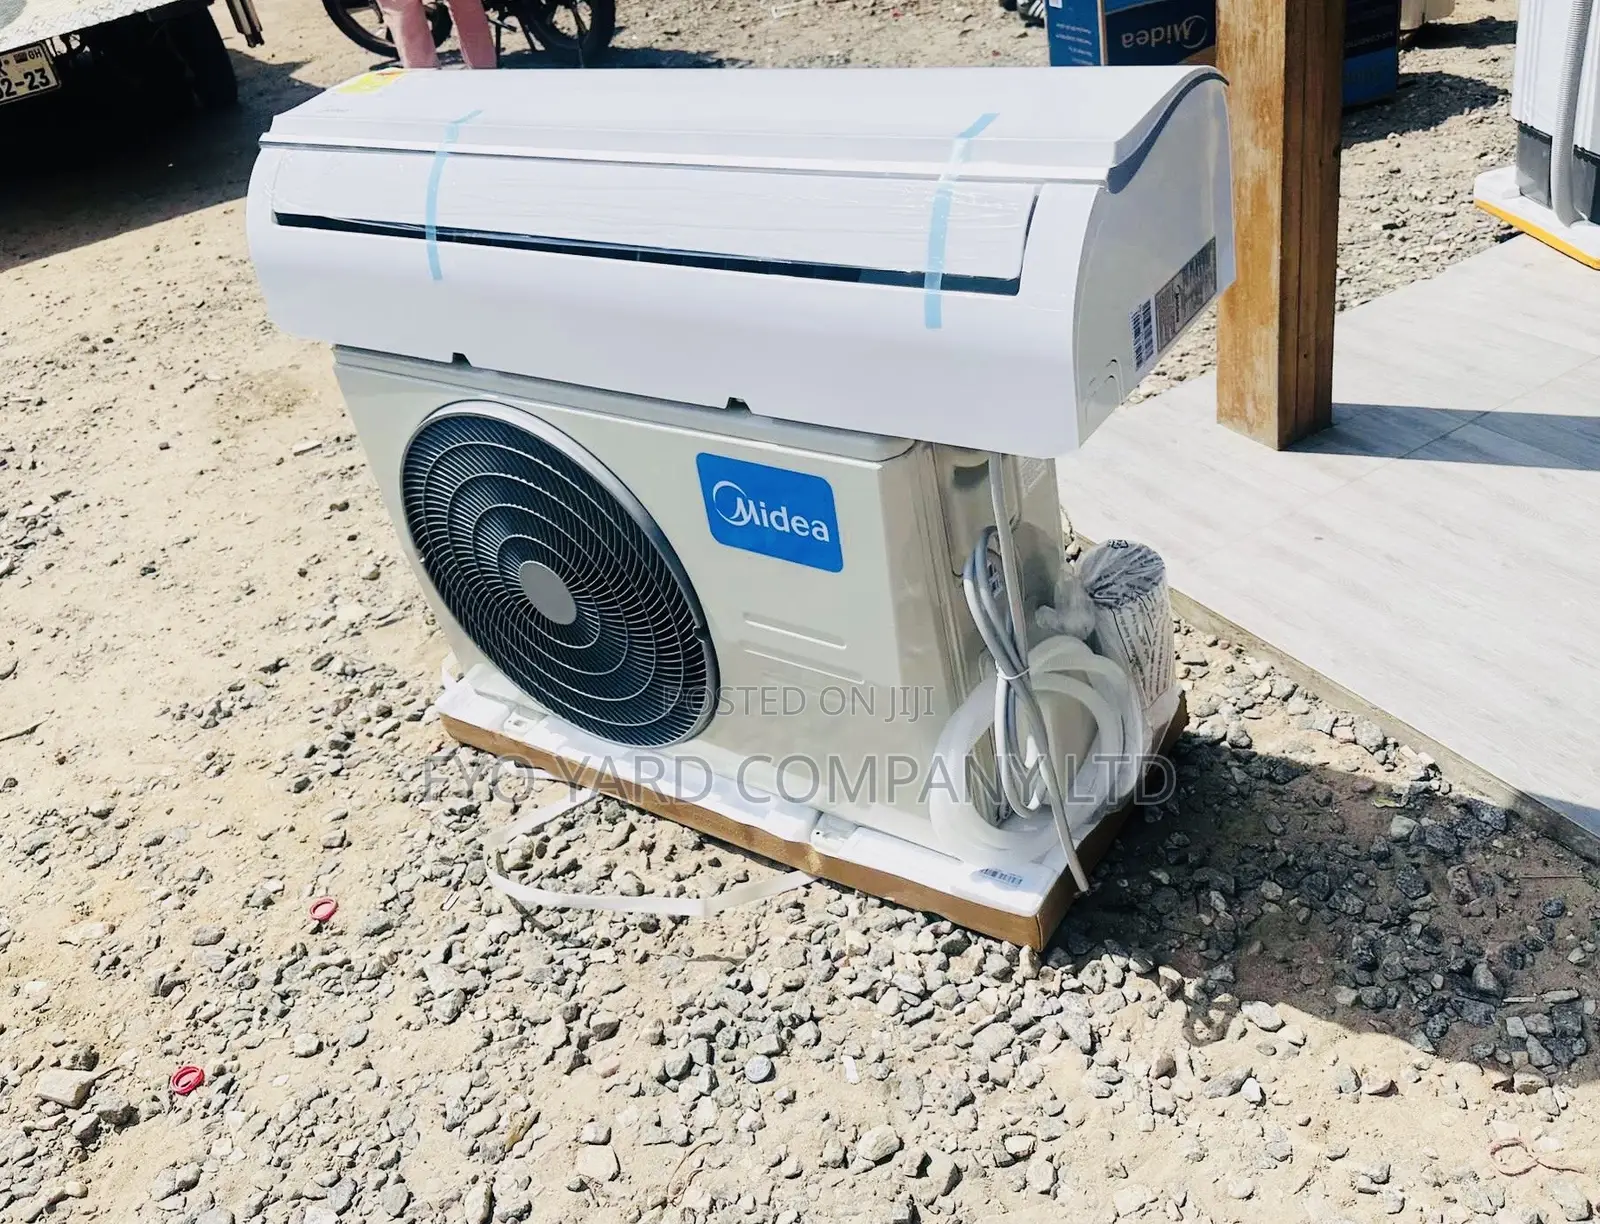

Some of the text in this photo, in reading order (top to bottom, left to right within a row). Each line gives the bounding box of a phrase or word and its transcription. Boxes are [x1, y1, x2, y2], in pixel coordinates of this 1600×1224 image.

[1121, 15, 1208, 48] Midea
[28, 48, 43, 60] GH
[712, 480, 830, 542] Midea
